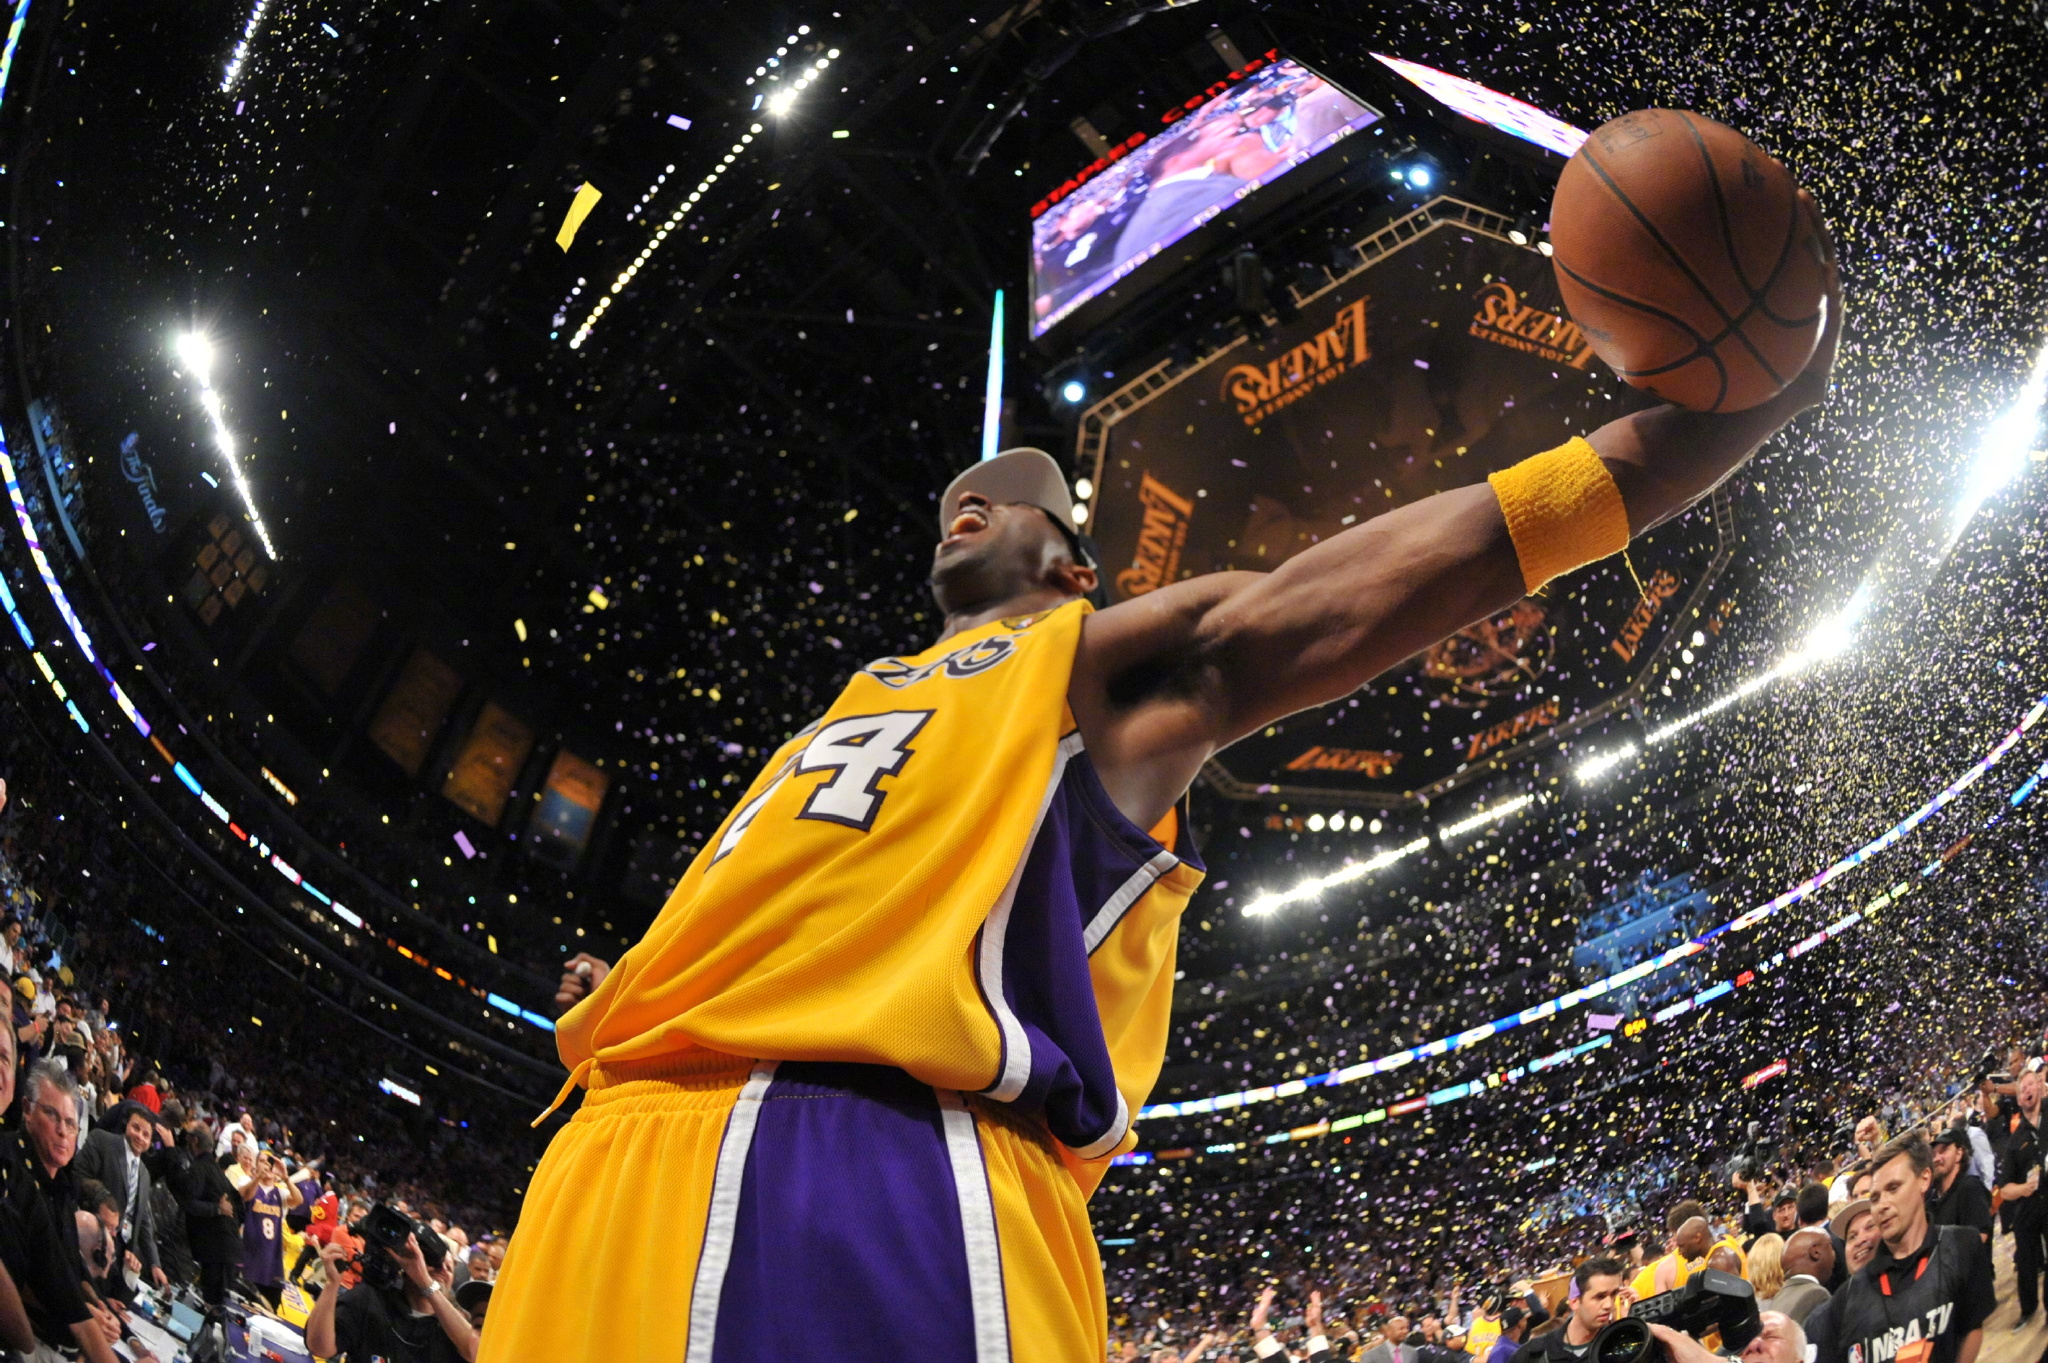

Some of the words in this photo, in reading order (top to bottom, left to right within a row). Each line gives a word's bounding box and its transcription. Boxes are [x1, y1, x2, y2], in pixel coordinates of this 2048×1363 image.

[1220, 294, 1372, 413] LAKERS
[262, 1217, 275, 1240] 8
[1872, 1317, 1922, 1363] NBA
[1925, 1301, 1954, 1339] TV
